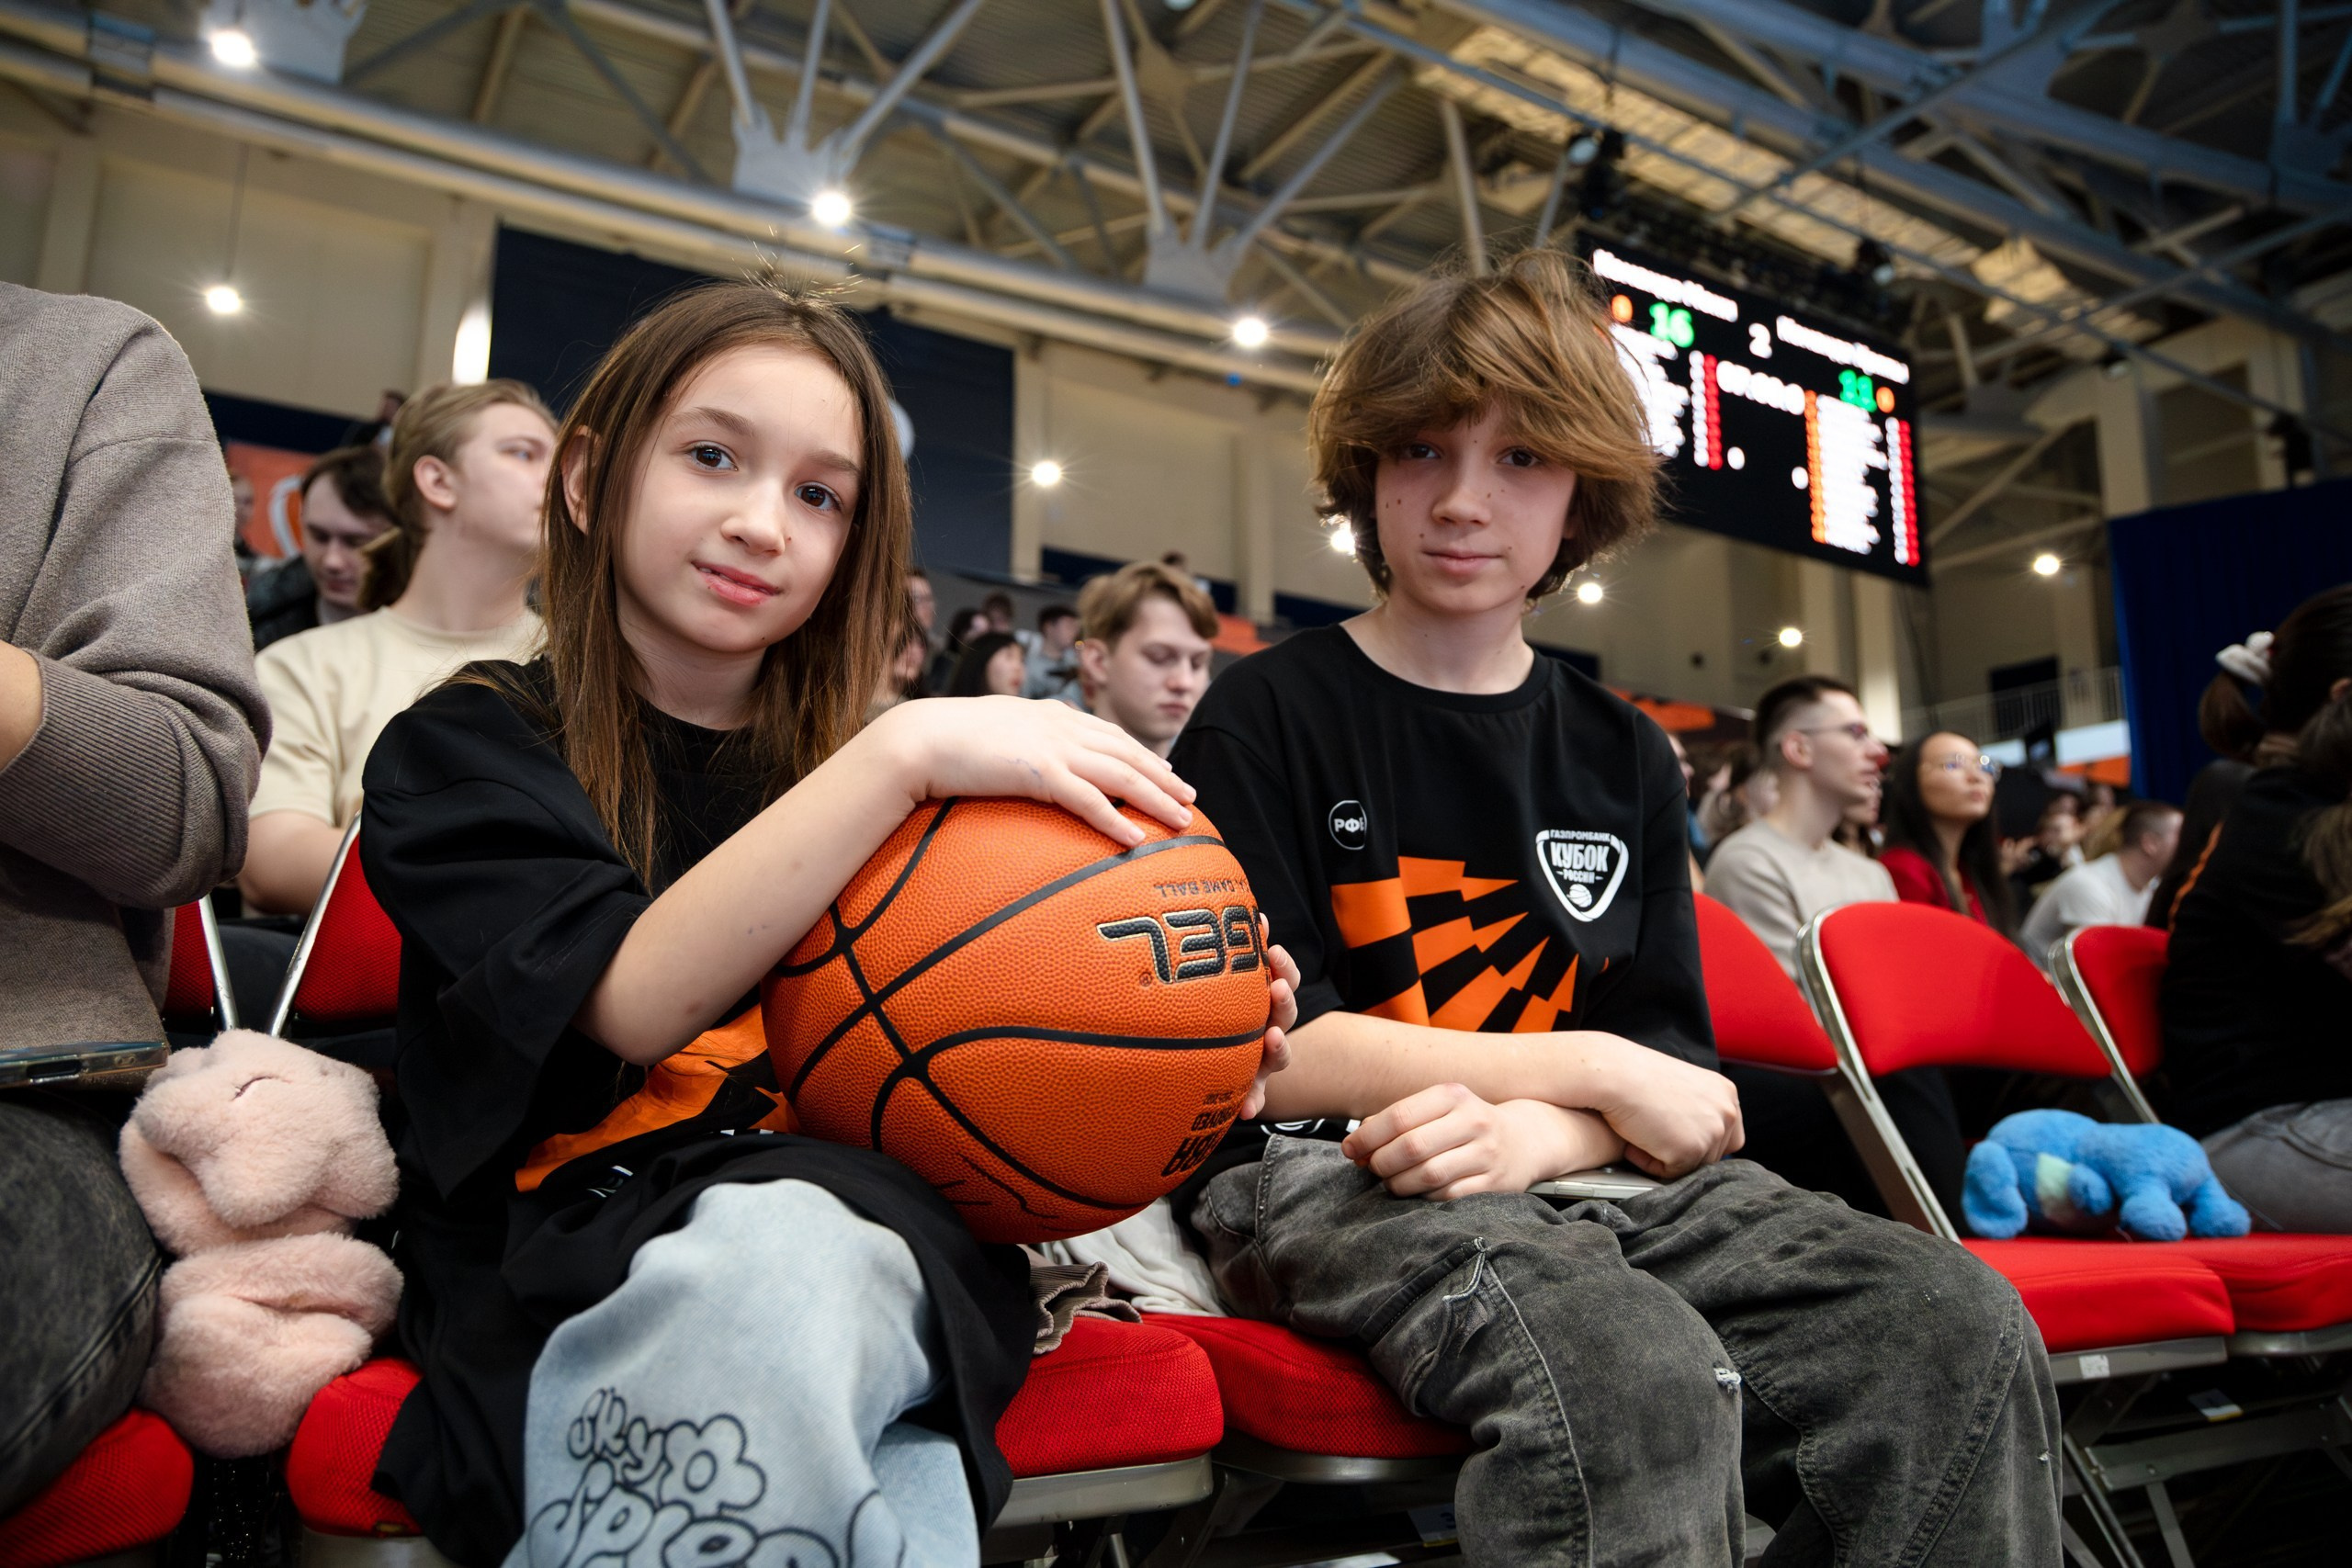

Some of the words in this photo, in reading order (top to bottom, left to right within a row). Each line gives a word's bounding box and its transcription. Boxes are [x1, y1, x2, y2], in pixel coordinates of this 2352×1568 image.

[1649, 302, 1694, 347] 16
[1748, 321, 1772, 359] 2
[1550, 829, 1611, 842] ГАЗПРОМБАНК
[1550, 841, 1610, 872] КУБОК
[1563, 869, 1595, 884] РОССИИ
[1154, 881, 1199, 897] BALL
